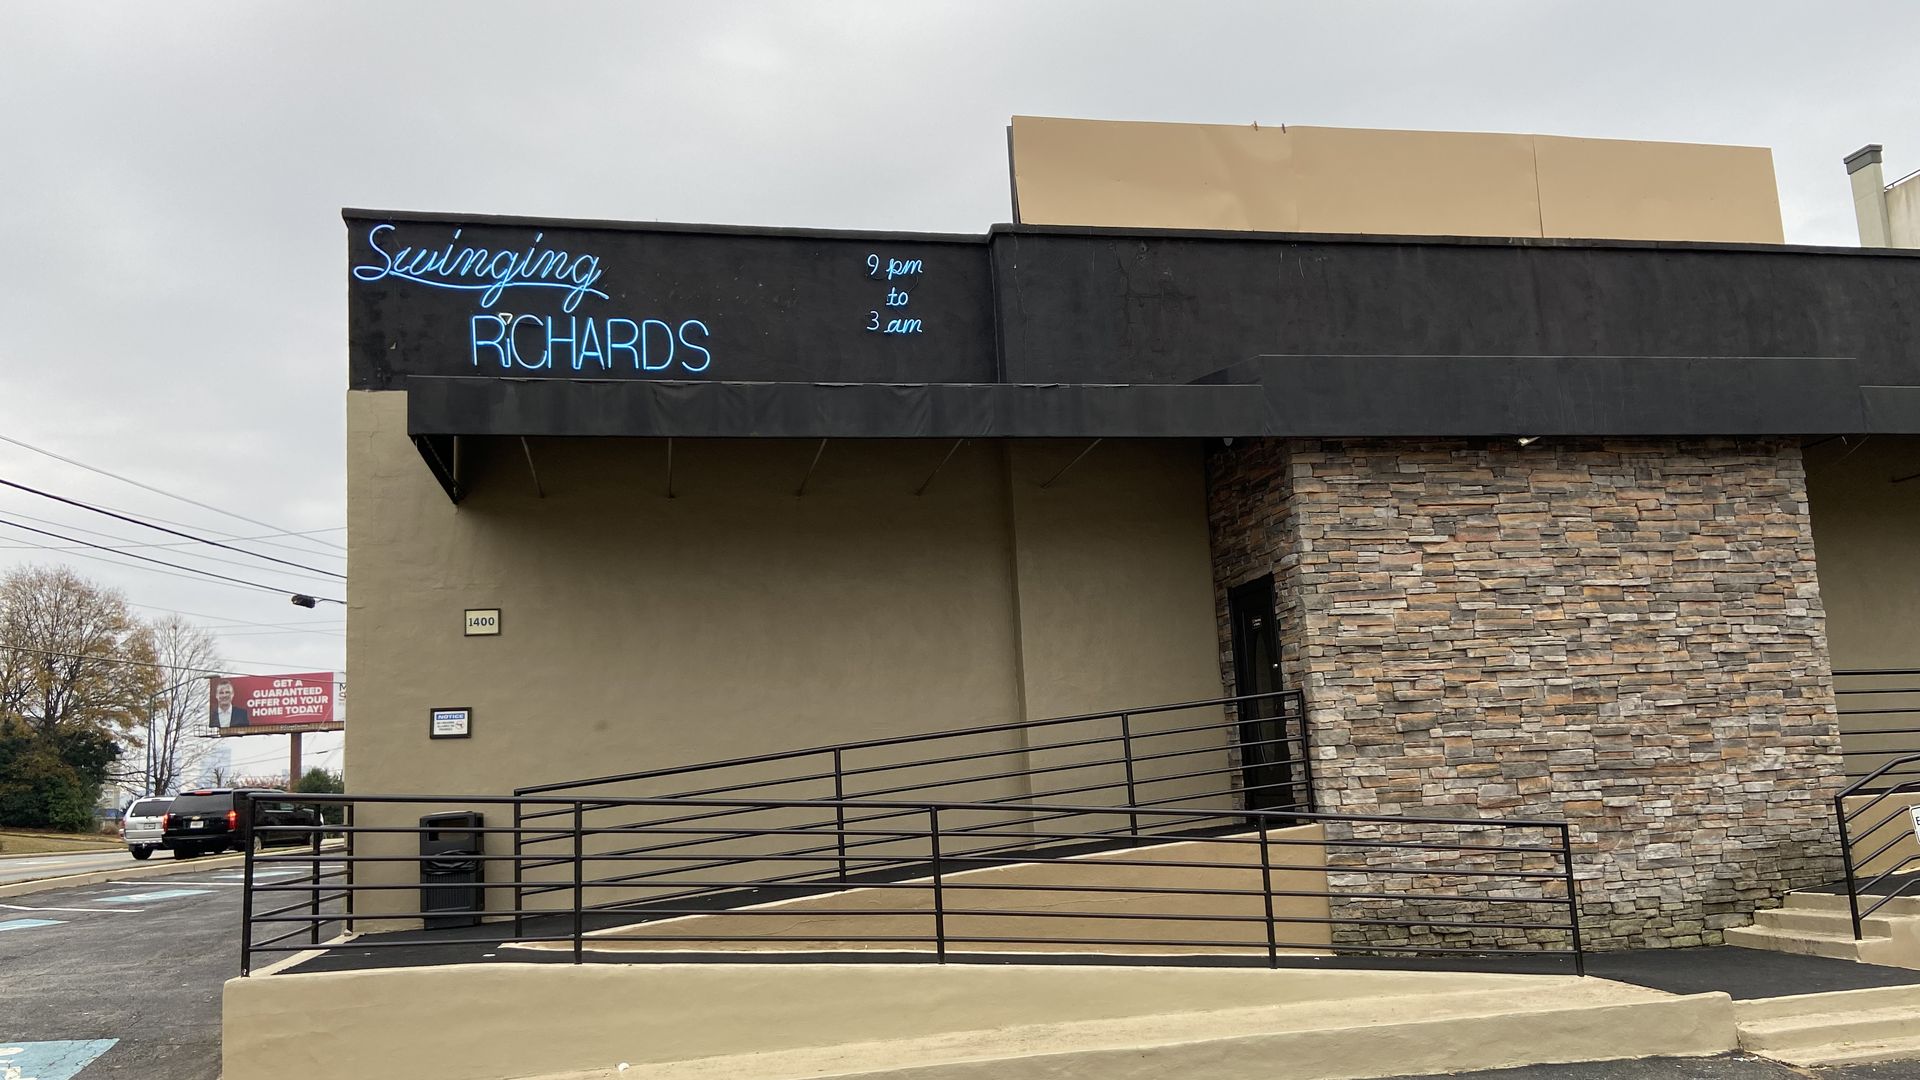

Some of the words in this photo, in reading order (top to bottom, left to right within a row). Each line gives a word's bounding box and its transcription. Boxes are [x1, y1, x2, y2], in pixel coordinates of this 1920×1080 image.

[353, 224, 609, 313] Swinging
[867, 254, 879, 275] 9
[886, 258, 923, 280] pm
[886, 287, 909, 306] to
[866, 311, 879, 330] 3
[884, 319, 923, 333] am
[468, 617, 495, 627] 1400
[273, 680, 292, 688] GET
[253, 687, 323, 698] GUARANTEED
[247, 699, 280, 708] OFFER
[282, 698, 298, 706] ON
[300, 696, 328, 704] YOUR
[252, 707, 282, 717] HOME
[285, 705, 323, 714] TODAY!
